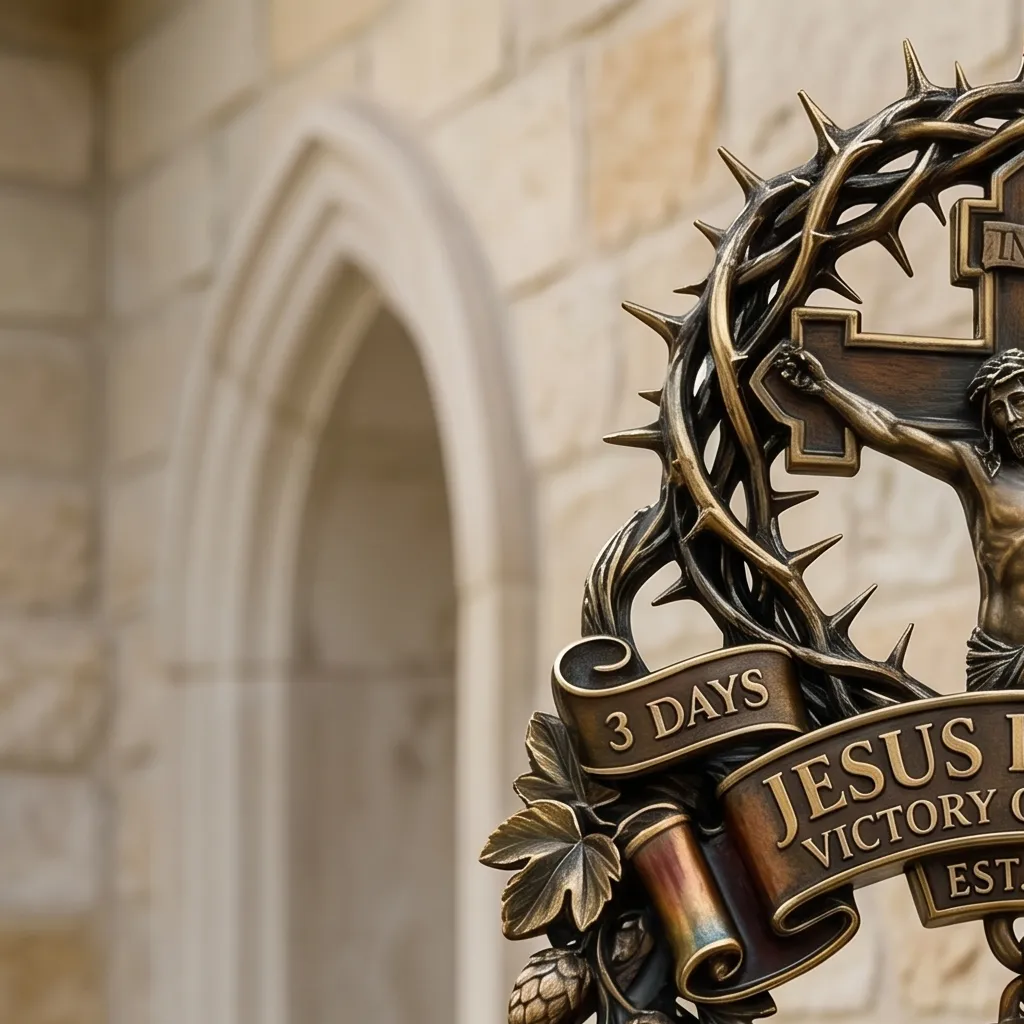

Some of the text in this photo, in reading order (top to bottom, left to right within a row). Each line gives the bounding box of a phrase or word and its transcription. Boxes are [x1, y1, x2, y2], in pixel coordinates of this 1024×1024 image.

[606, 668, 769, 751] 3 DAYS
[762, 717, 983, 849] JESUS
[801, 788, 997, 868] VICTORY
